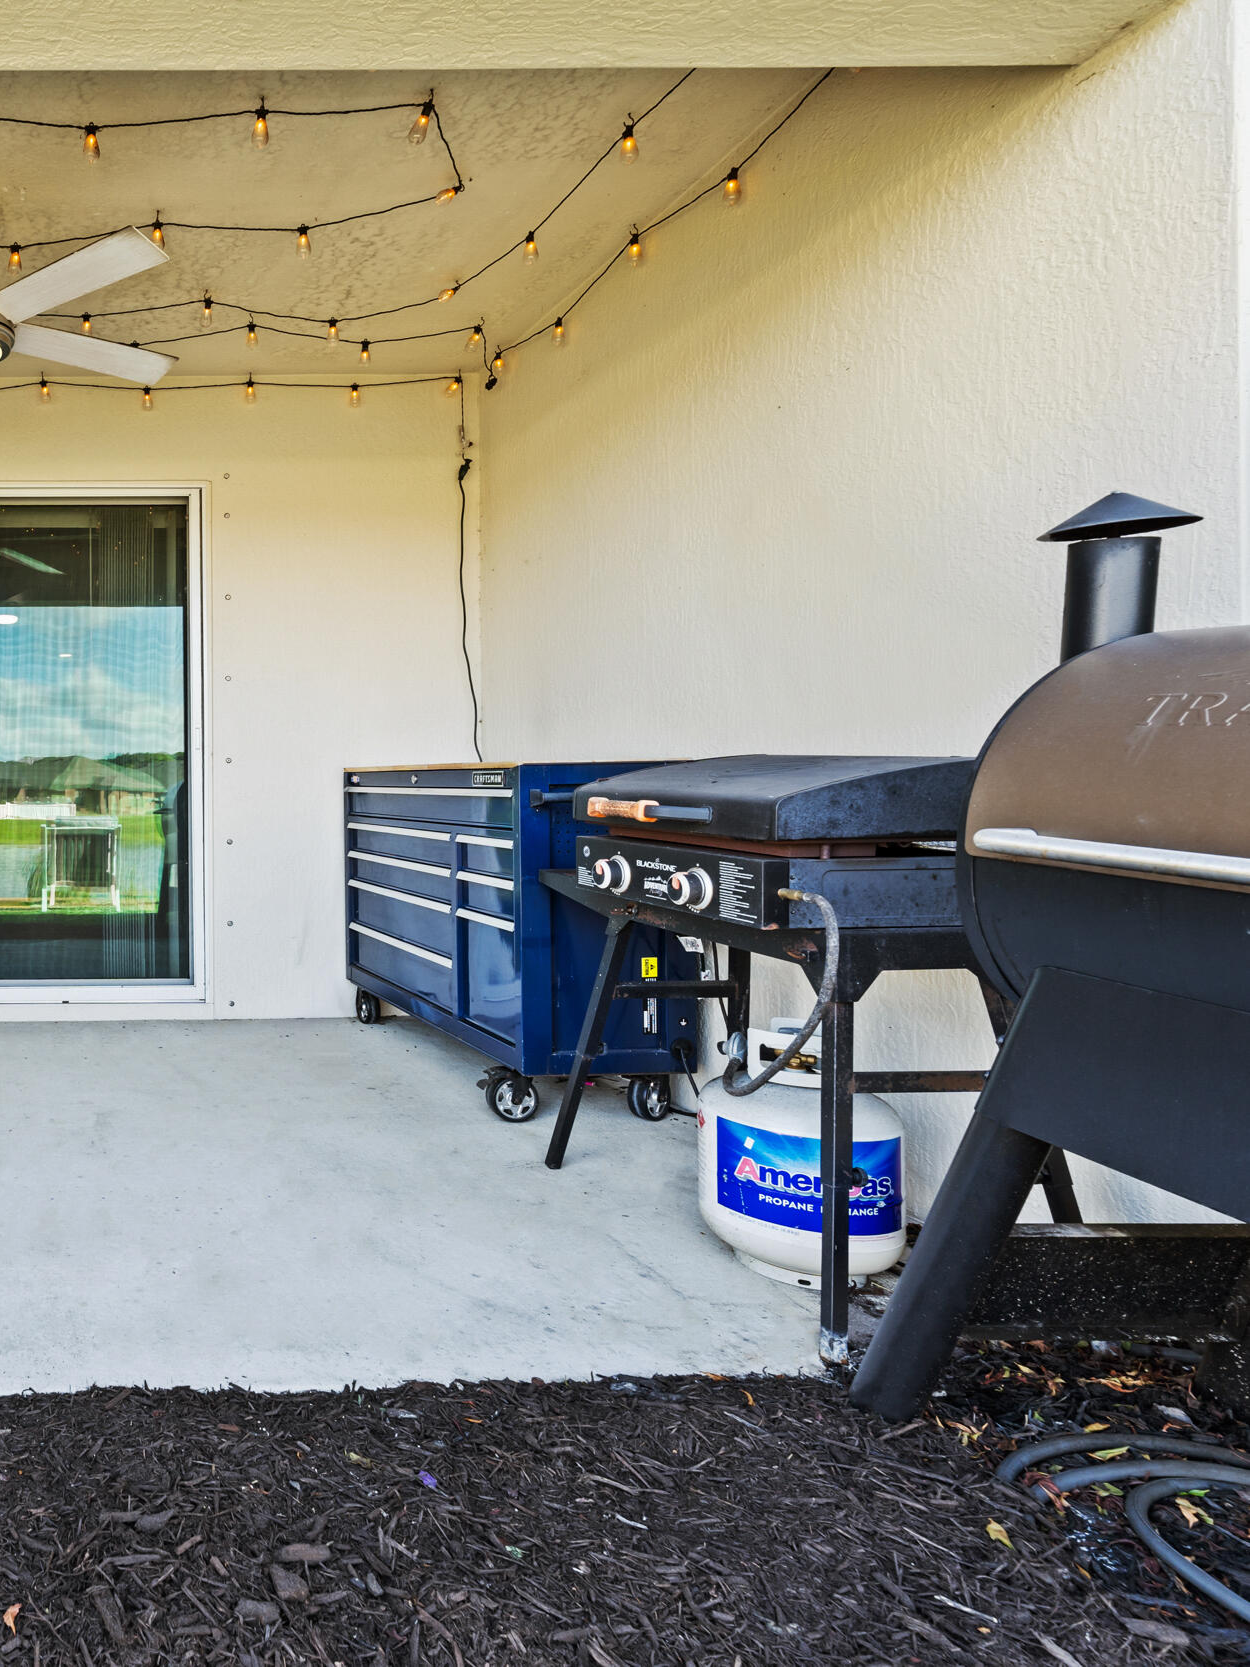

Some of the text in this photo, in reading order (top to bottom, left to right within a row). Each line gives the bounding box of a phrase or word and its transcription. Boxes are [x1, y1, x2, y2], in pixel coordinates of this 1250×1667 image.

[473, 774, 502, 784] CRAFTSMAN
[636, 860, 677, 872] BLACKSTONE
[734, 1156, 892, 1198] Ameras
[759, 1194, 814, 1212] PROPANE
